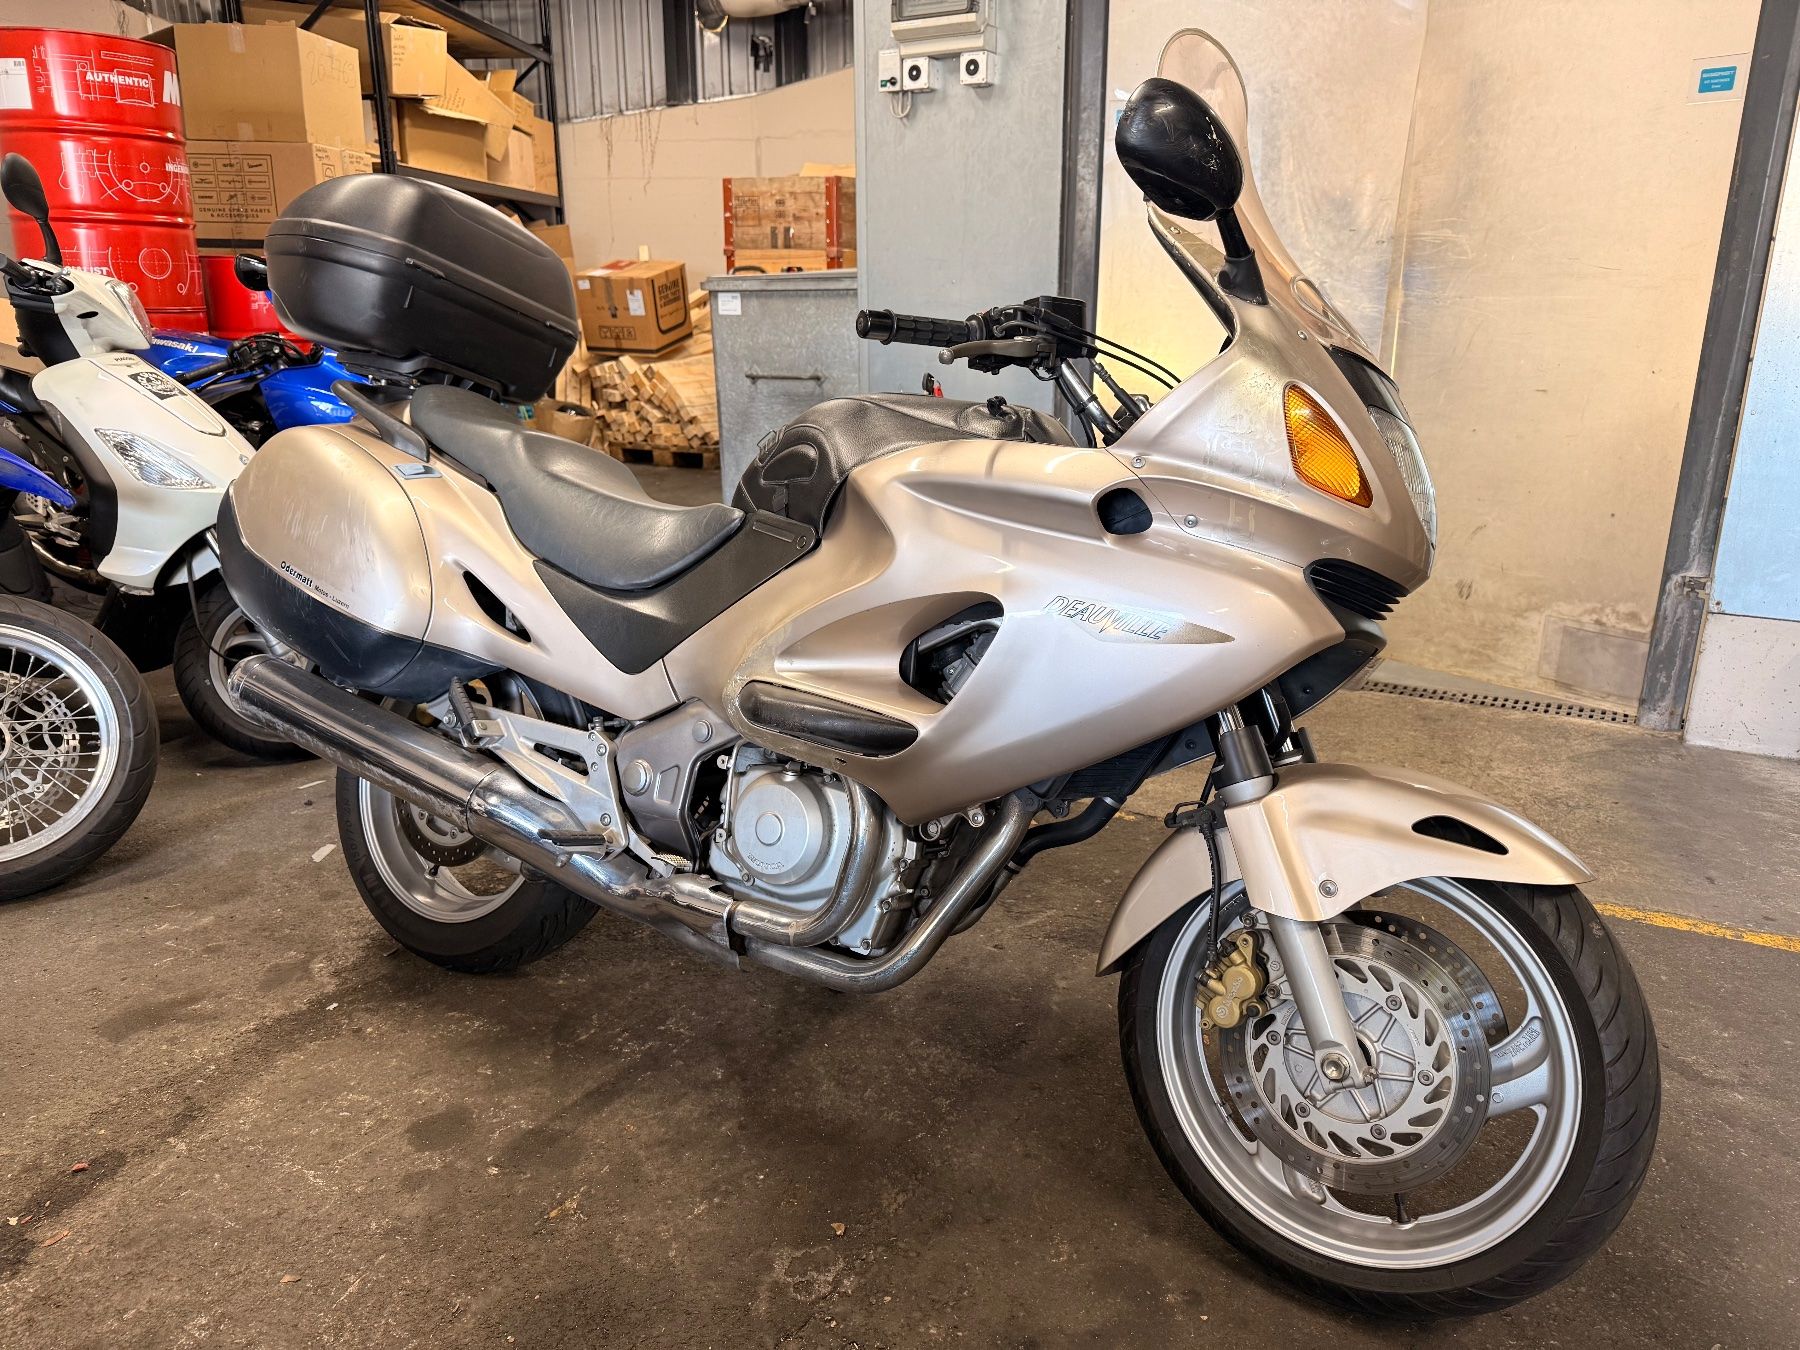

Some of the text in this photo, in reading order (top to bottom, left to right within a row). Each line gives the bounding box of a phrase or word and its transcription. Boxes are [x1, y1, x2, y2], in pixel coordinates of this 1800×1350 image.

[86, 71, 149, 88] AUTHENTIC
[280, 560, 313, 587] Odermatt
[314, 585, 329, 598] Motos
[1044, 595, 1168, 640] DEAUVILLE
